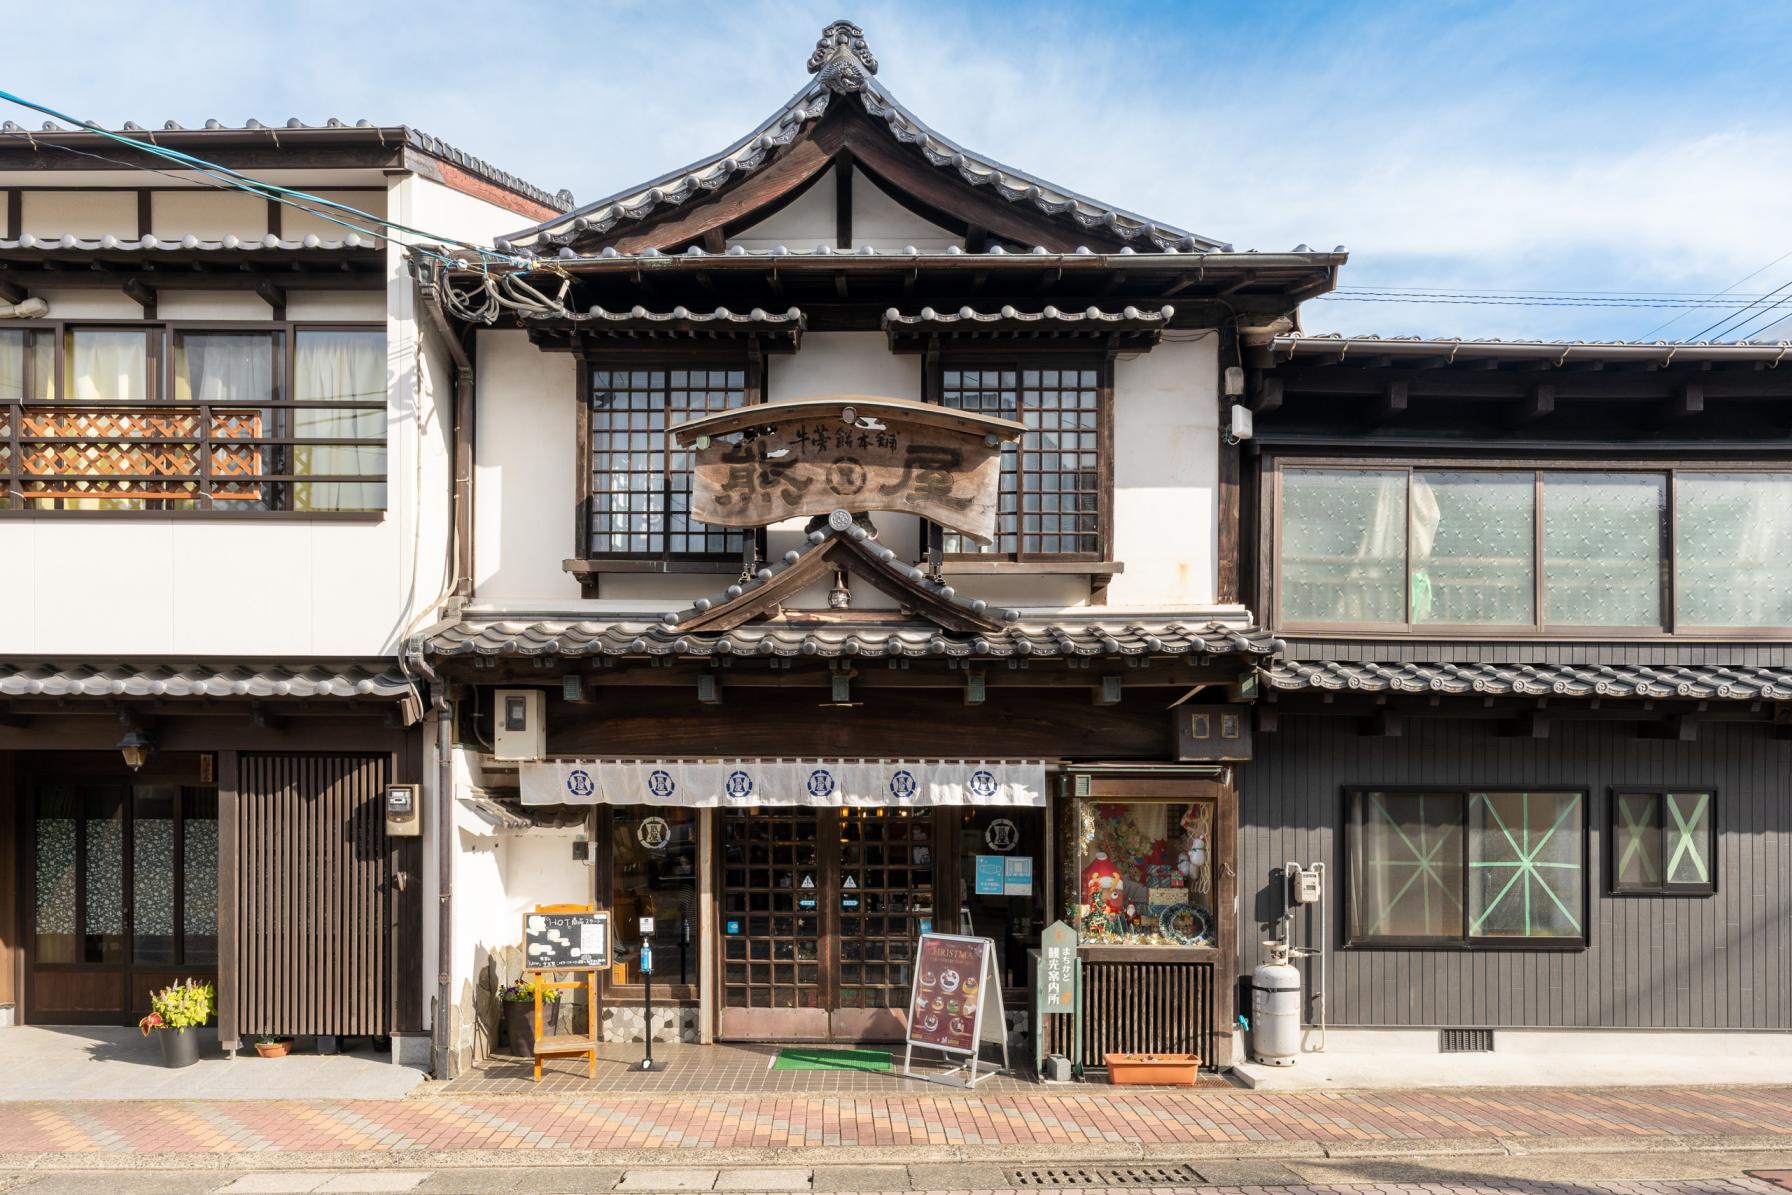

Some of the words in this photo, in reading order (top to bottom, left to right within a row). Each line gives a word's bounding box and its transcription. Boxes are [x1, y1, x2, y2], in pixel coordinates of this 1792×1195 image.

[1047, 947, 1060, 1005] 観光案内所
[1062, 947, 1071, 982] まちかど
